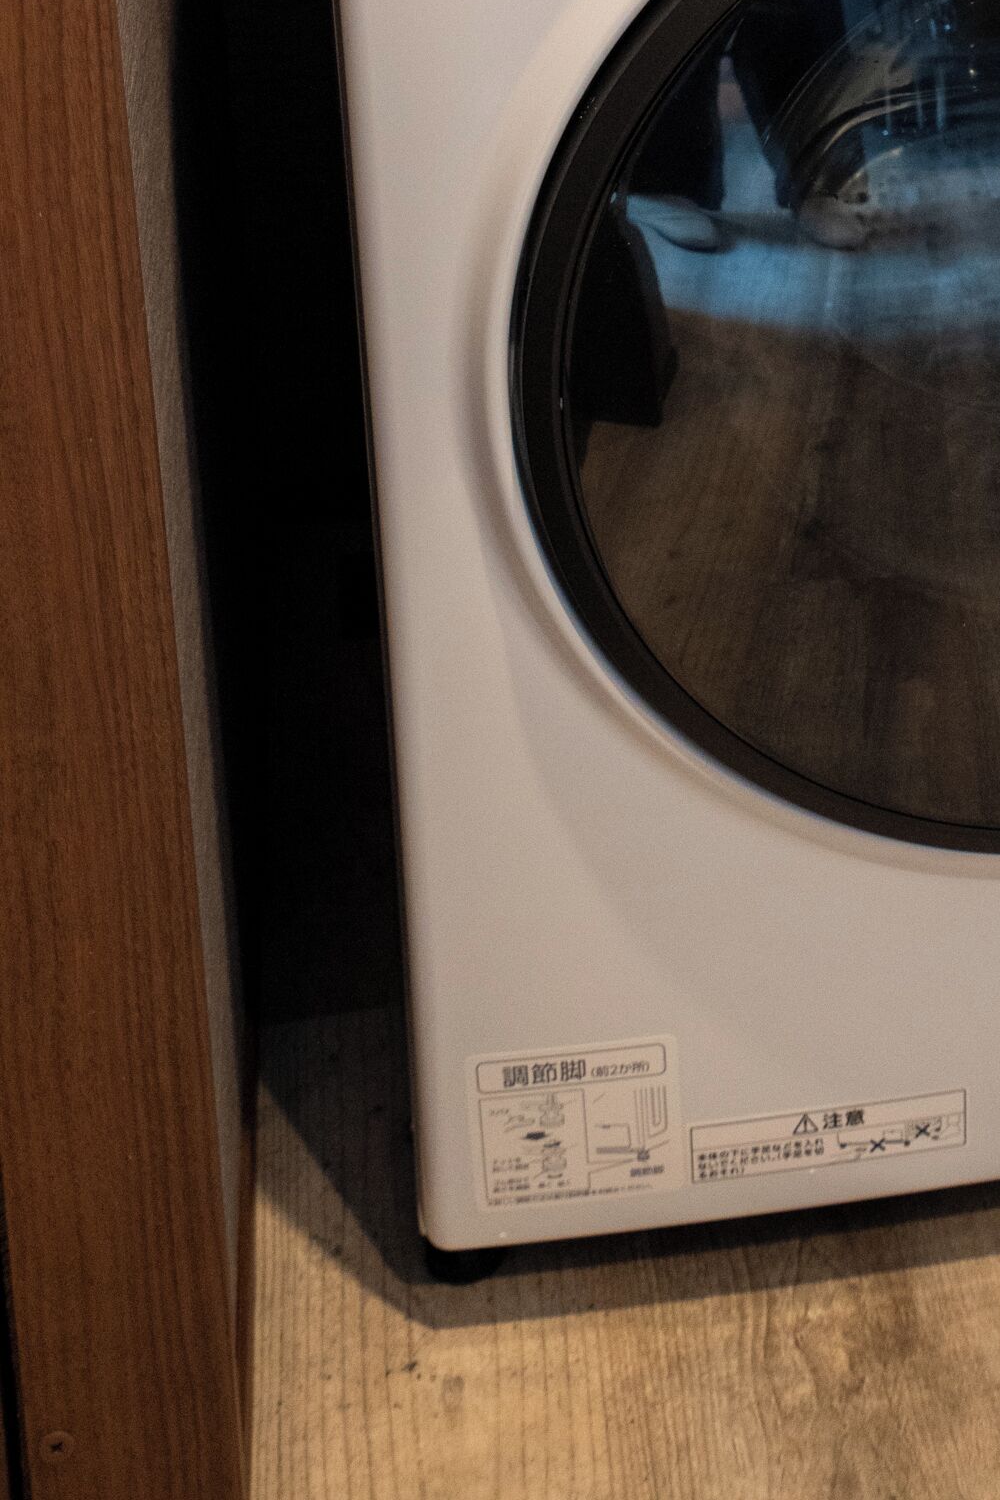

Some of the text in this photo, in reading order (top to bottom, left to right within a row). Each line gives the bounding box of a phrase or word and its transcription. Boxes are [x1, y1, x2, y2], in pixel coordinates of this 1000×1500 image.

[503, 1059, 586, 1088] 調節脚
[822, 1109, 864, 1130] 注意
